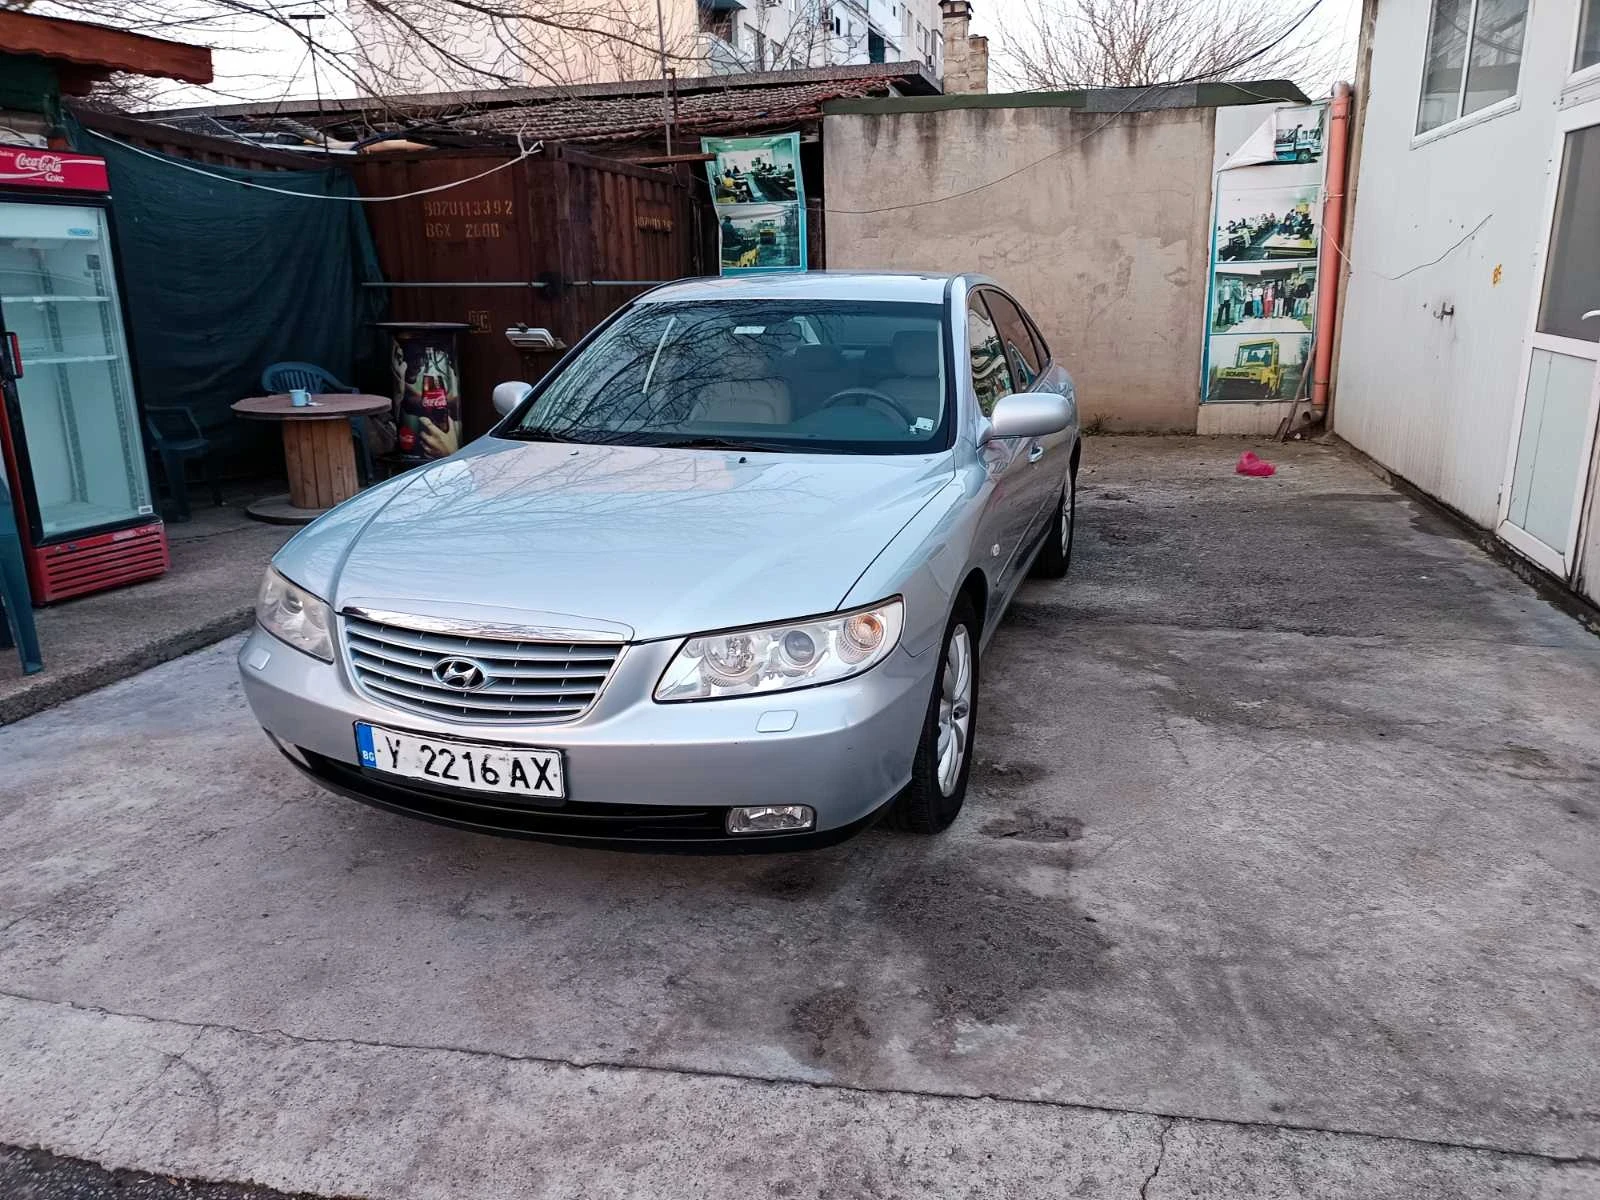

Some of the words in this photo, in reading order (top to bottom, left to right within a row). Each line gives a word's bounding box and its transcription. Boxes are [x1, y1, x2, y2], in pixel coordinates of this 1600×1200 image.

[15, 152, 62, 173] Coca-Cola
[45, 172, 65, 183] Coke
[362, 750, 375, 762] BG
[385, 735, 400, 769] Y
[420, 744, 500, 786] 2216
[510, 756, 554, 792] AX
